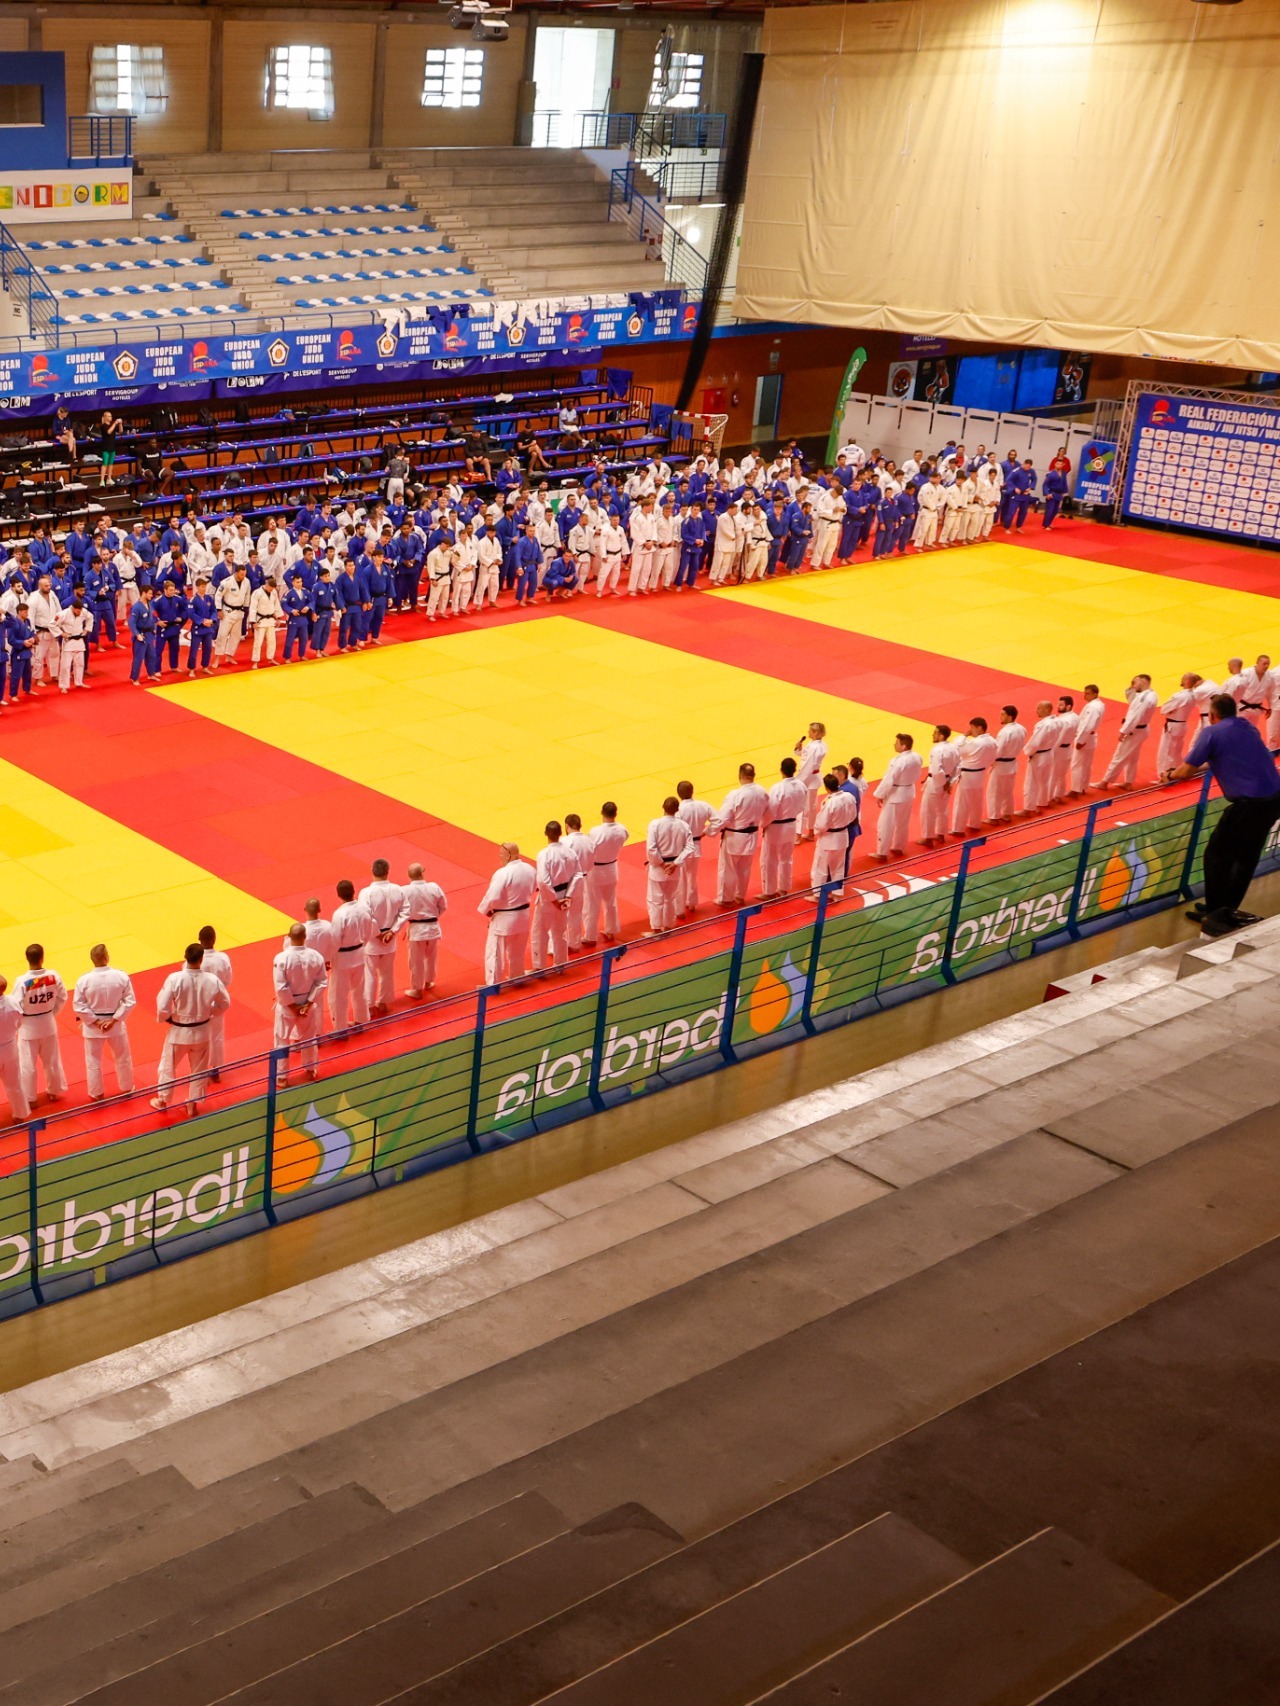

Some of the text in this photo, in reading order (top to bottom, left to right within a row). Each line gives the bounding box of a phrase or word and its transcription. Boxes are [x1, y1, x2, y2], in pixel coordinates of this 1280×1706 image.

[224, 339, 260, 351] EUROPEAN
[296, 334, 331, 345] EUROPEAN
[145, 345, 183, 357] EUROPEAN
[304, 344, 322, 354] JUDO
[66, 352, 105, 364] EUROPEAN
[233, 350, 252, 360] JUDO
[302, 353, 324, 364] UNION
[155, 356, 173, 367] JUDO
[231, 359, 255, 370] UNION
[76, 363, 95, 374] JUDO
[153, 366, 175, 377] UNION
[73, 373, 98, 385] UNION
[104, 388, 139, 396] SERVIGROUP
[1179, 404, 1205, 419] REAL
[1206, 407, 1276, 428] FEDERACIÓN
[1186, 419, 1216, 431] AIKIDO
[1234, 425, 1259, 437] JITSU
[29, 991, 54, 1004] UZB
